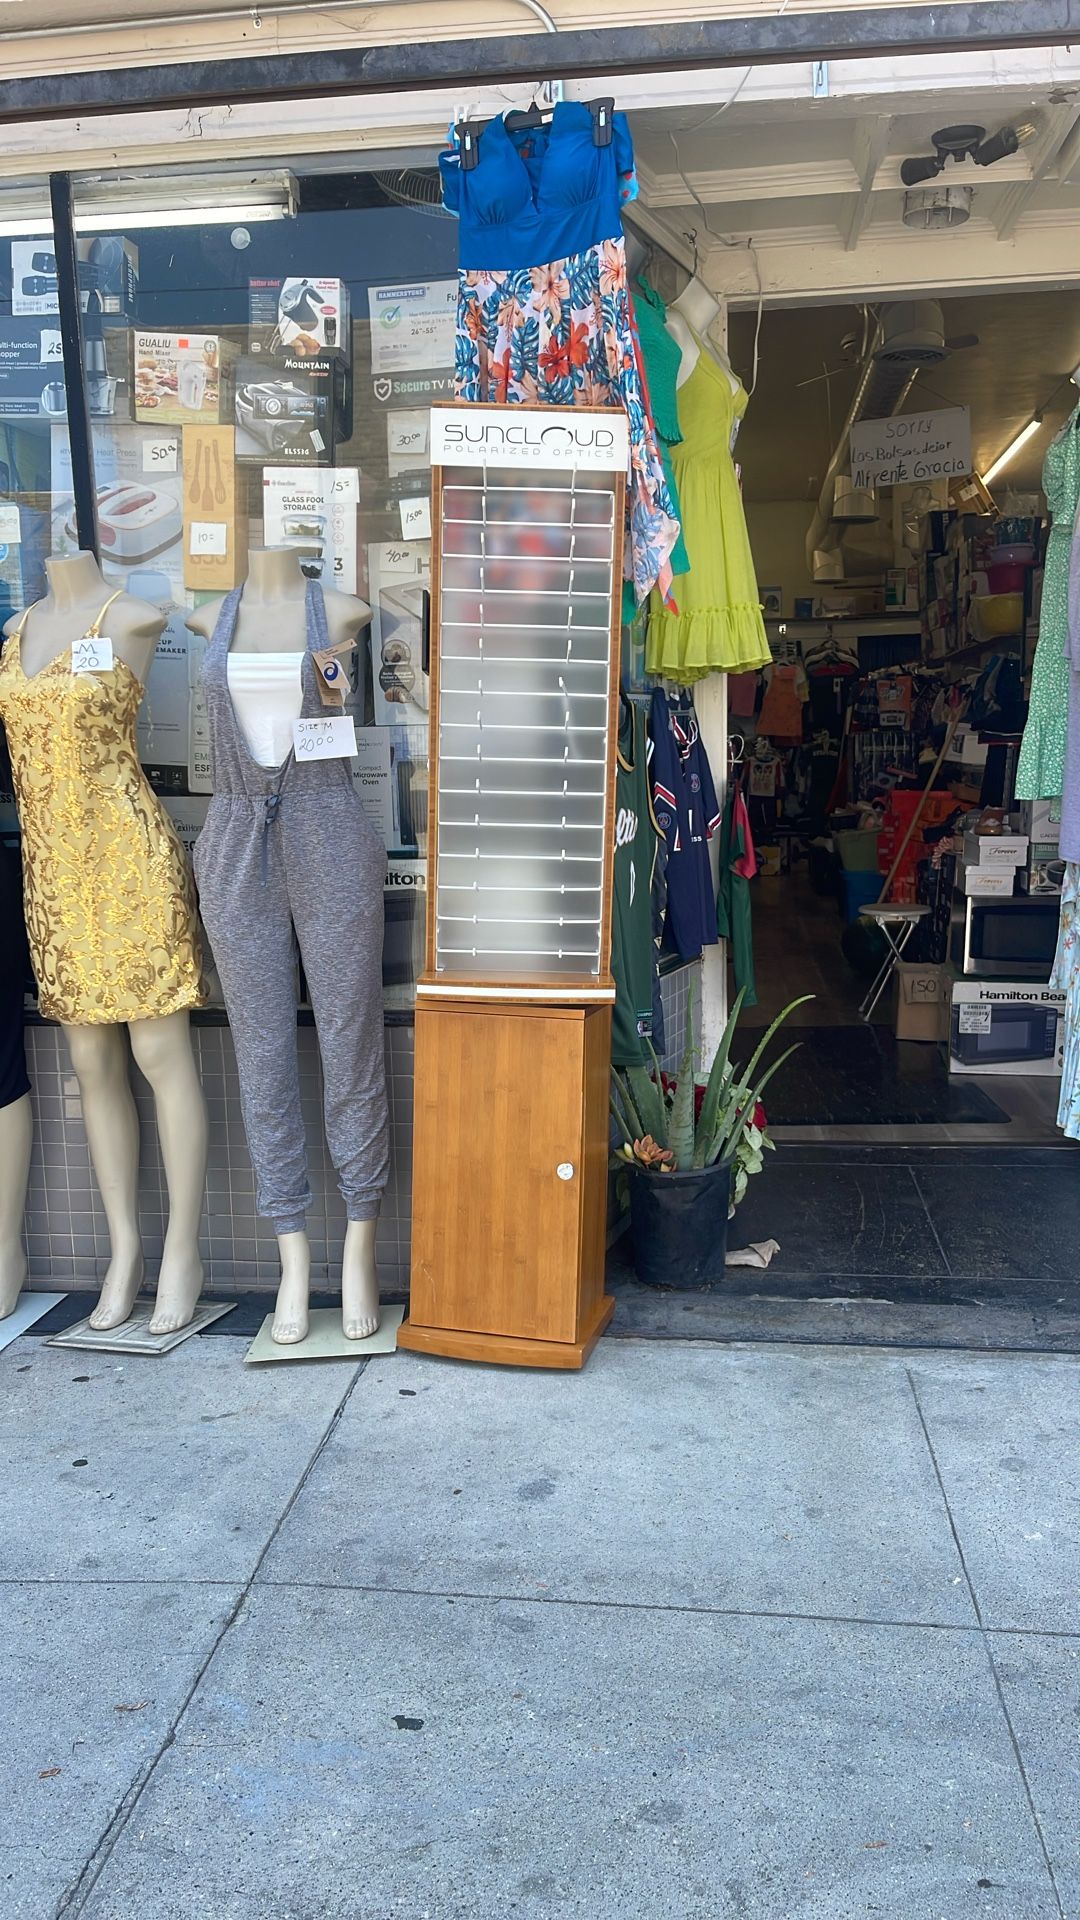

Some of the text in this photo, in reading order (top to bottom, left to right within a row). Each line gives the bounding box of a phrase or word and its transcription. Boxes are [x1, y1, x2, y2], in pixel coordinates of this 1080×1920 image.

[447, 293, 458, 302] Fu
[138, 338, 171, 348] GUALIU
[393, 380, 431, 394] Secure
[431, 379, 445, 390] TV
[444, 424, 614, 447] SUNCLOUD
[443, 444, 614, 458] POLARIZED OPTICS
[333, 557, 344, 571] 3
[76, 657, 99, 669] 20
[988, 846, 1018, 855] Forever
[384, 872, 426, 886] ilton
[979, 990, 1067, 1001] Hamilton Bea
